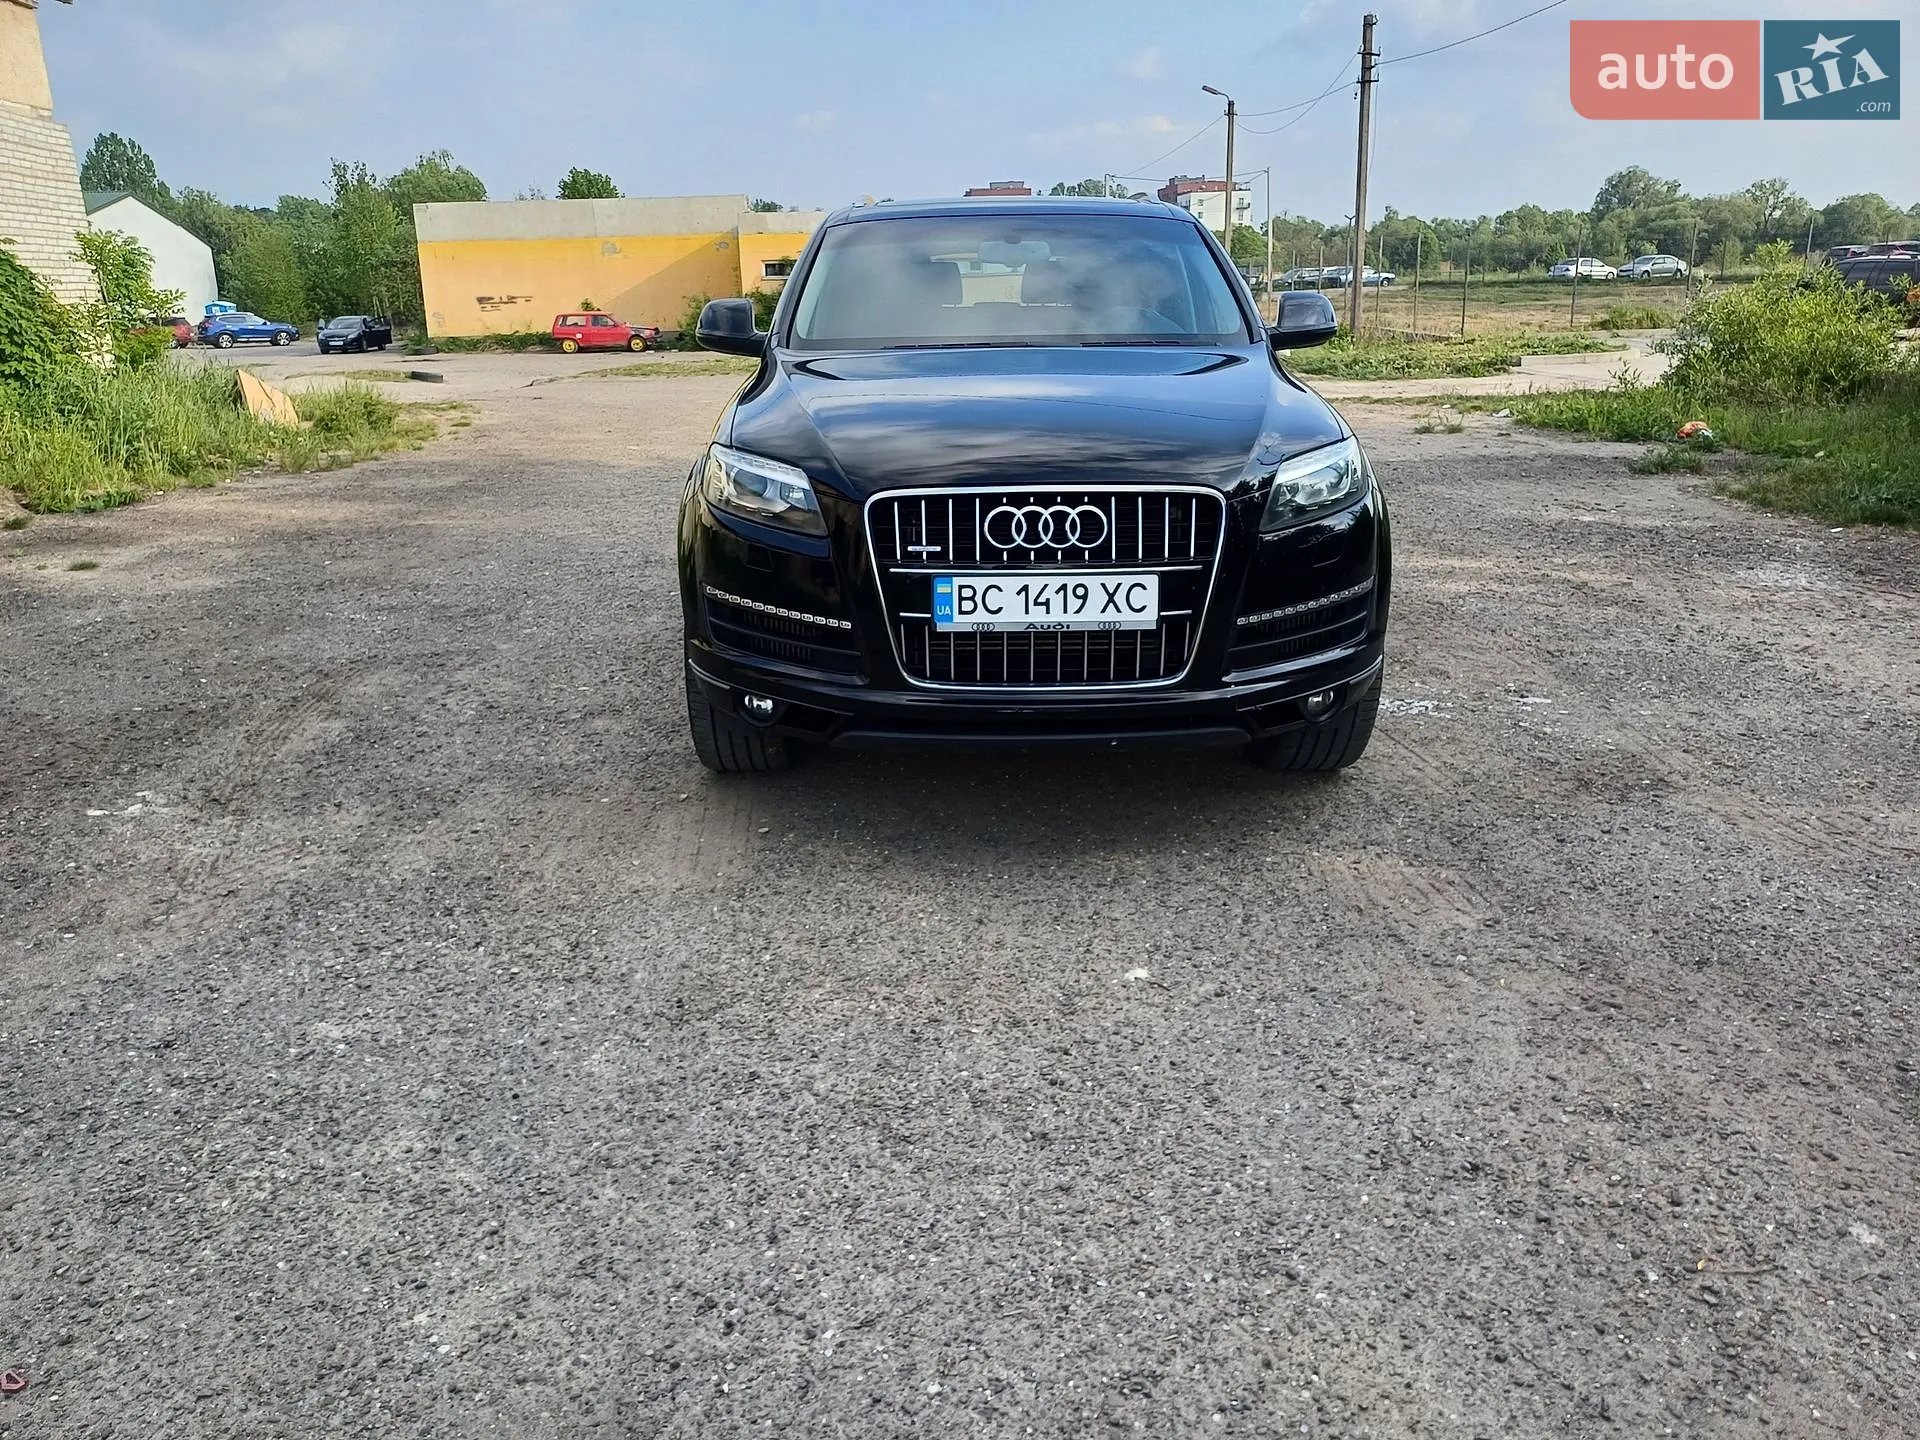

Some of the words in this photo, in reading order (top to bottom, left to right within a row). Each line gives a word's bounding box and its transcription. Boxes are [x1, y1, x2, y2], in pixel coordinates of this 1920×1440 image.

[957, 584, 1004, 616] BC
[1015, 582, 1089, 616] 1419
[1100, 582, 1148, 614] XC
[936, 605, 952, 617] UA
[1024, 622, 1071, 631] Audi
